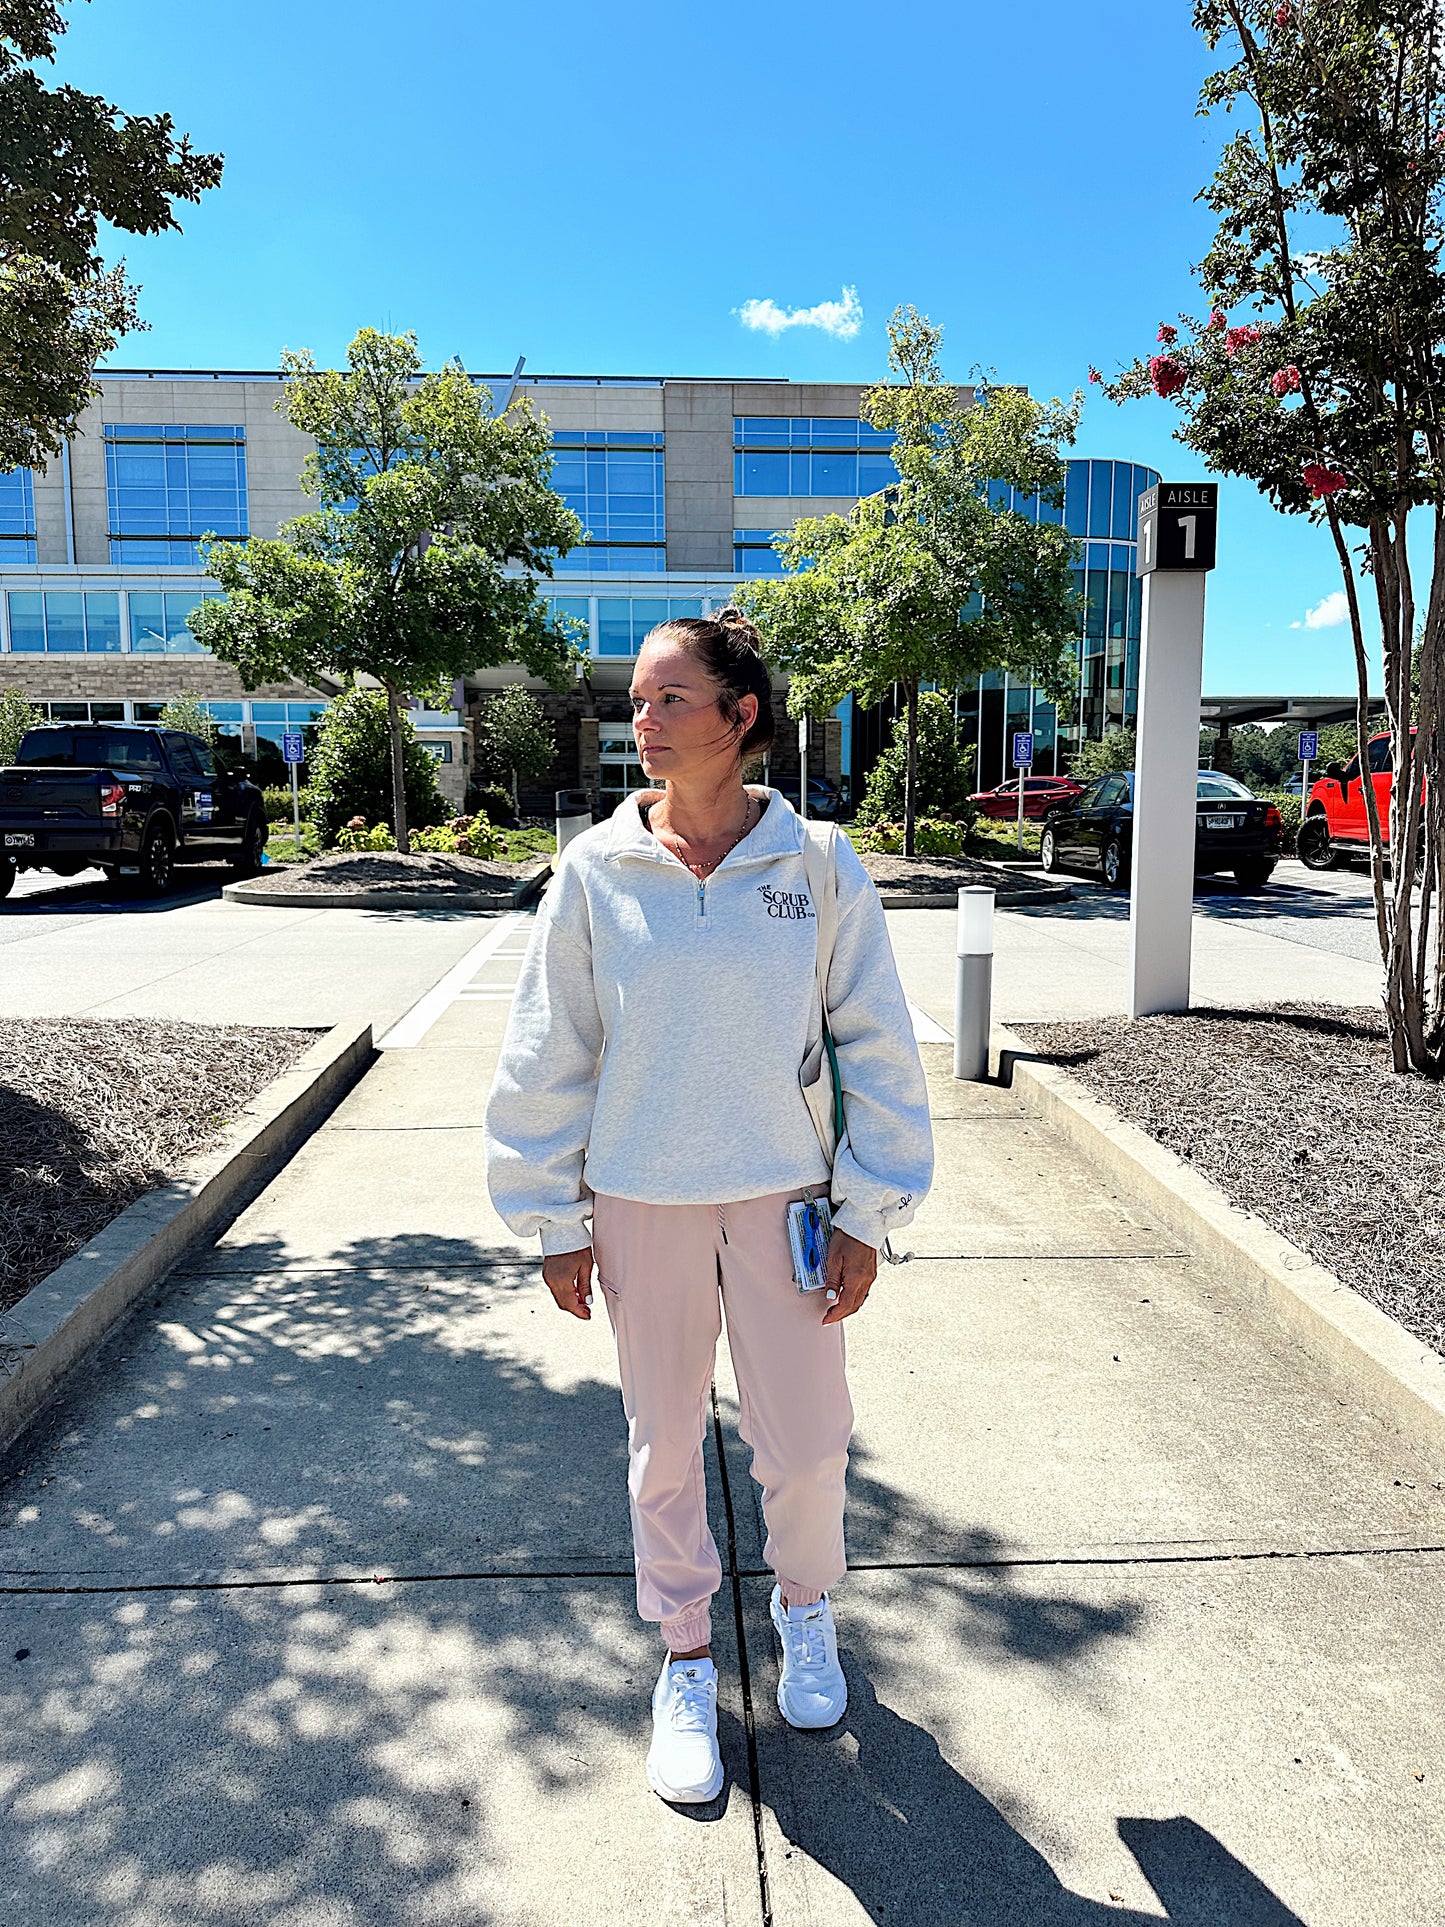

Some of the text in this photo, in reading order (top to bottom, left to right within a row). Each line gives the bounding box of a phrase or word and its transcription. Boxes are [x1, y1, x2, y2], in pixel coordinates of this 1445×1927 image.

[1140, 492, 1156, 514] AISLE
[1167, 490, 1209, 504] AISLE
[1143, 519, 1152, 565] 1
[1177, 515, 1197, 559] 1
[757, 884, 772, 892] THE
[762, 890, 809, 907] SCRUB
[767, 903, 807, 920] CLUB
